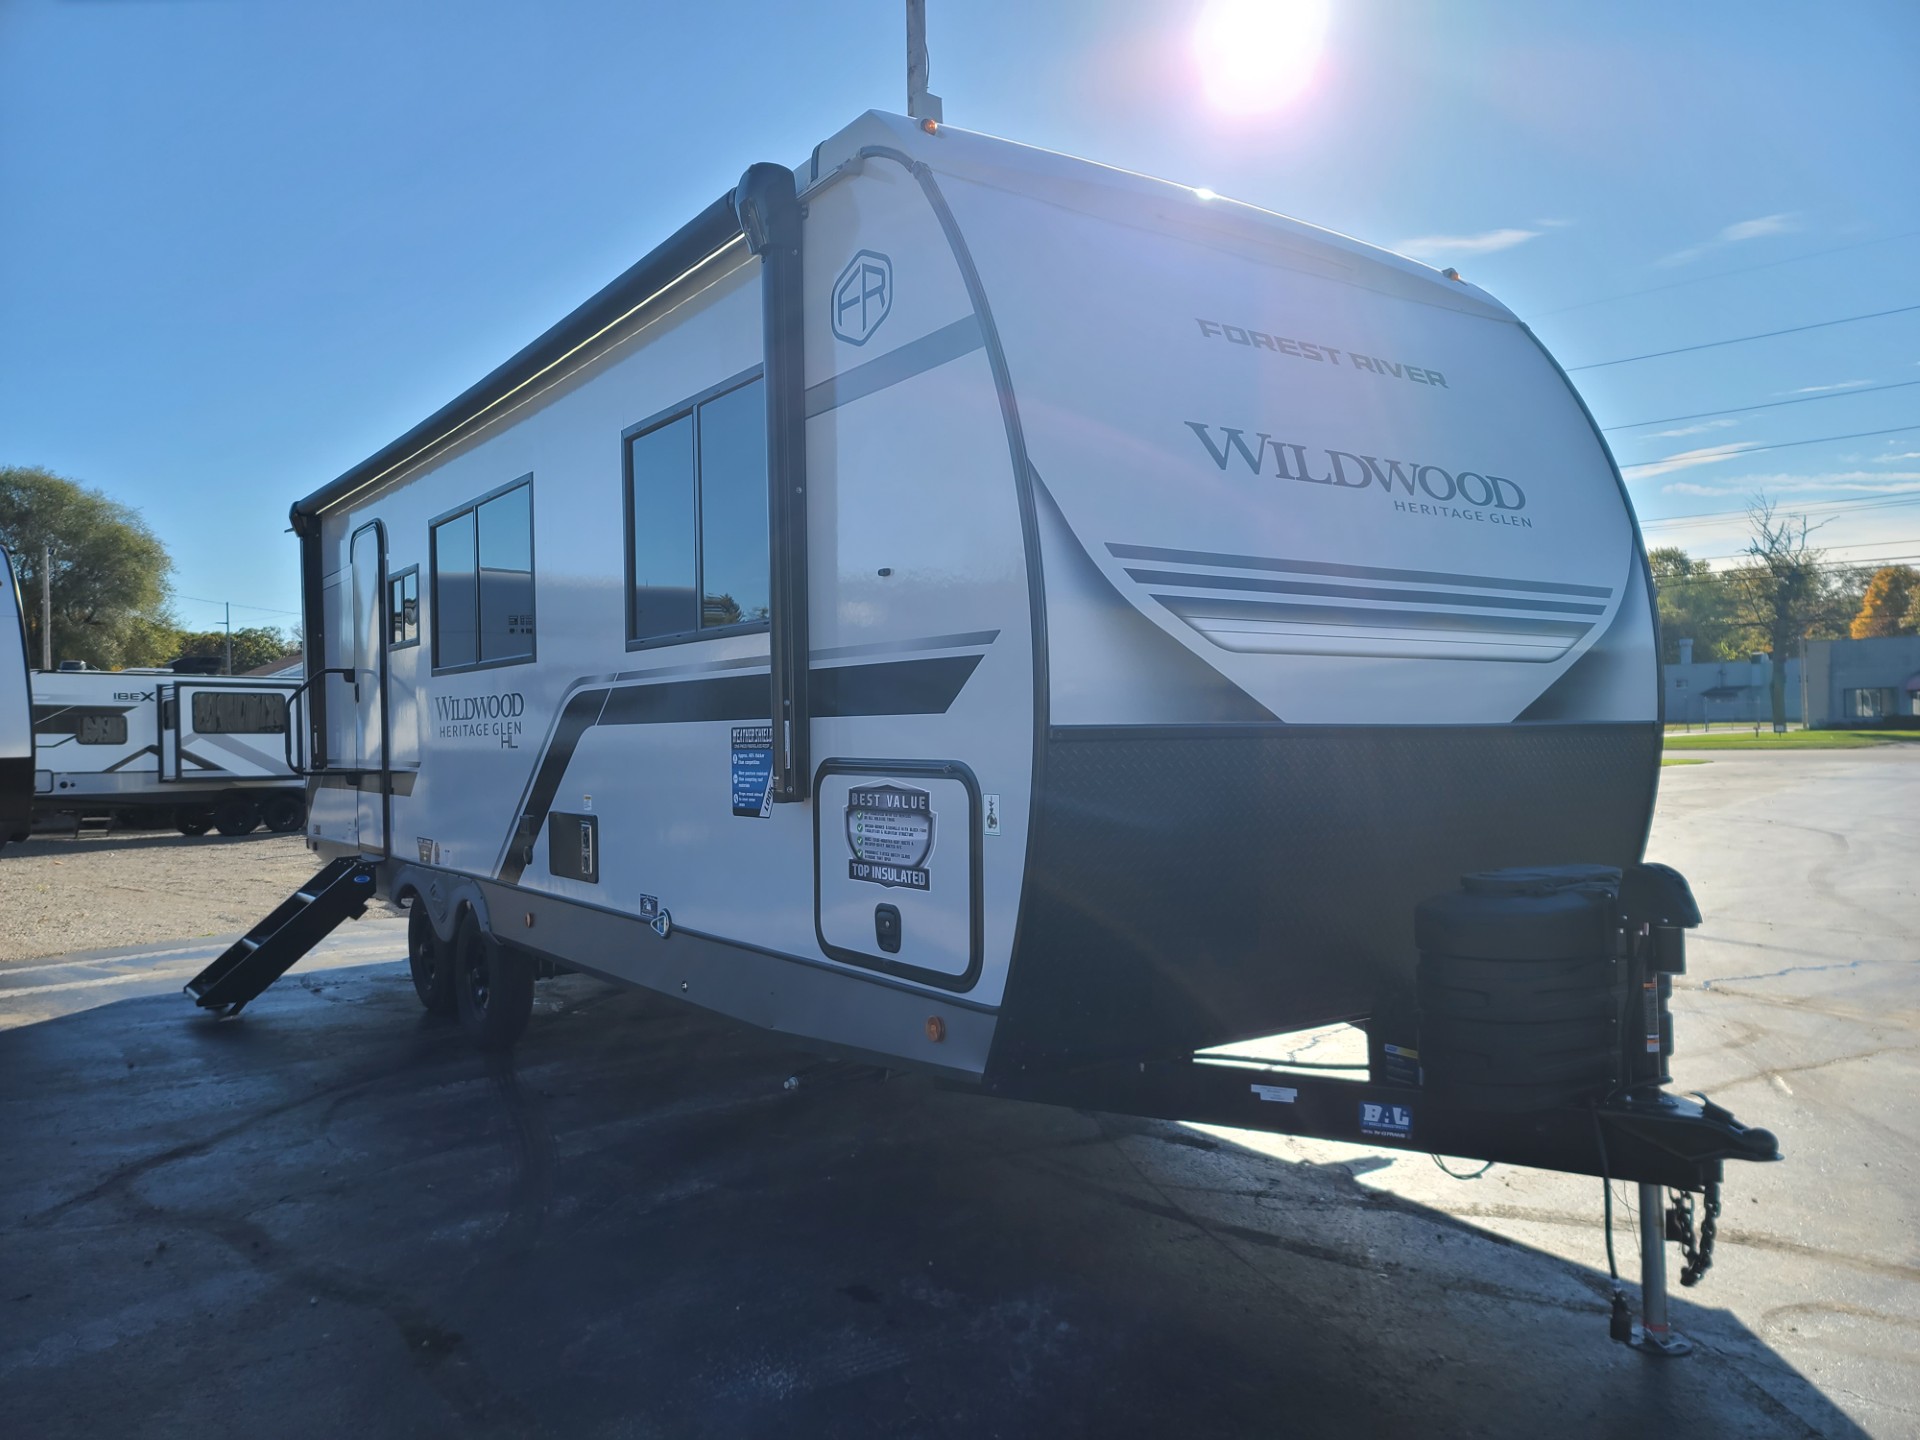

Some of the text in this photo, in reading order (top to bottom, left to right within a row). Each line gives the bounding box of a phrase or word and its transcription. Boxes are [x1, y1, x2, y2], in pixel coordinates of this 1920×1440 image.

[1195, 318, 1449, 389] FOREST RIVER
[1184, 421, 1526, 511] WILDWOOD
[1394, 500, 1532, 528] HERITAGE GLEN
[113, 692, 155, 702] IBEX
[435, 693, 524, 721] WILDWOOD
[440, 721, 522, 738] HERITAGE GLEN
[851, 793, 926, 810] BEST VALUE
[852, 863, 926, 886] TOP INSULATED
